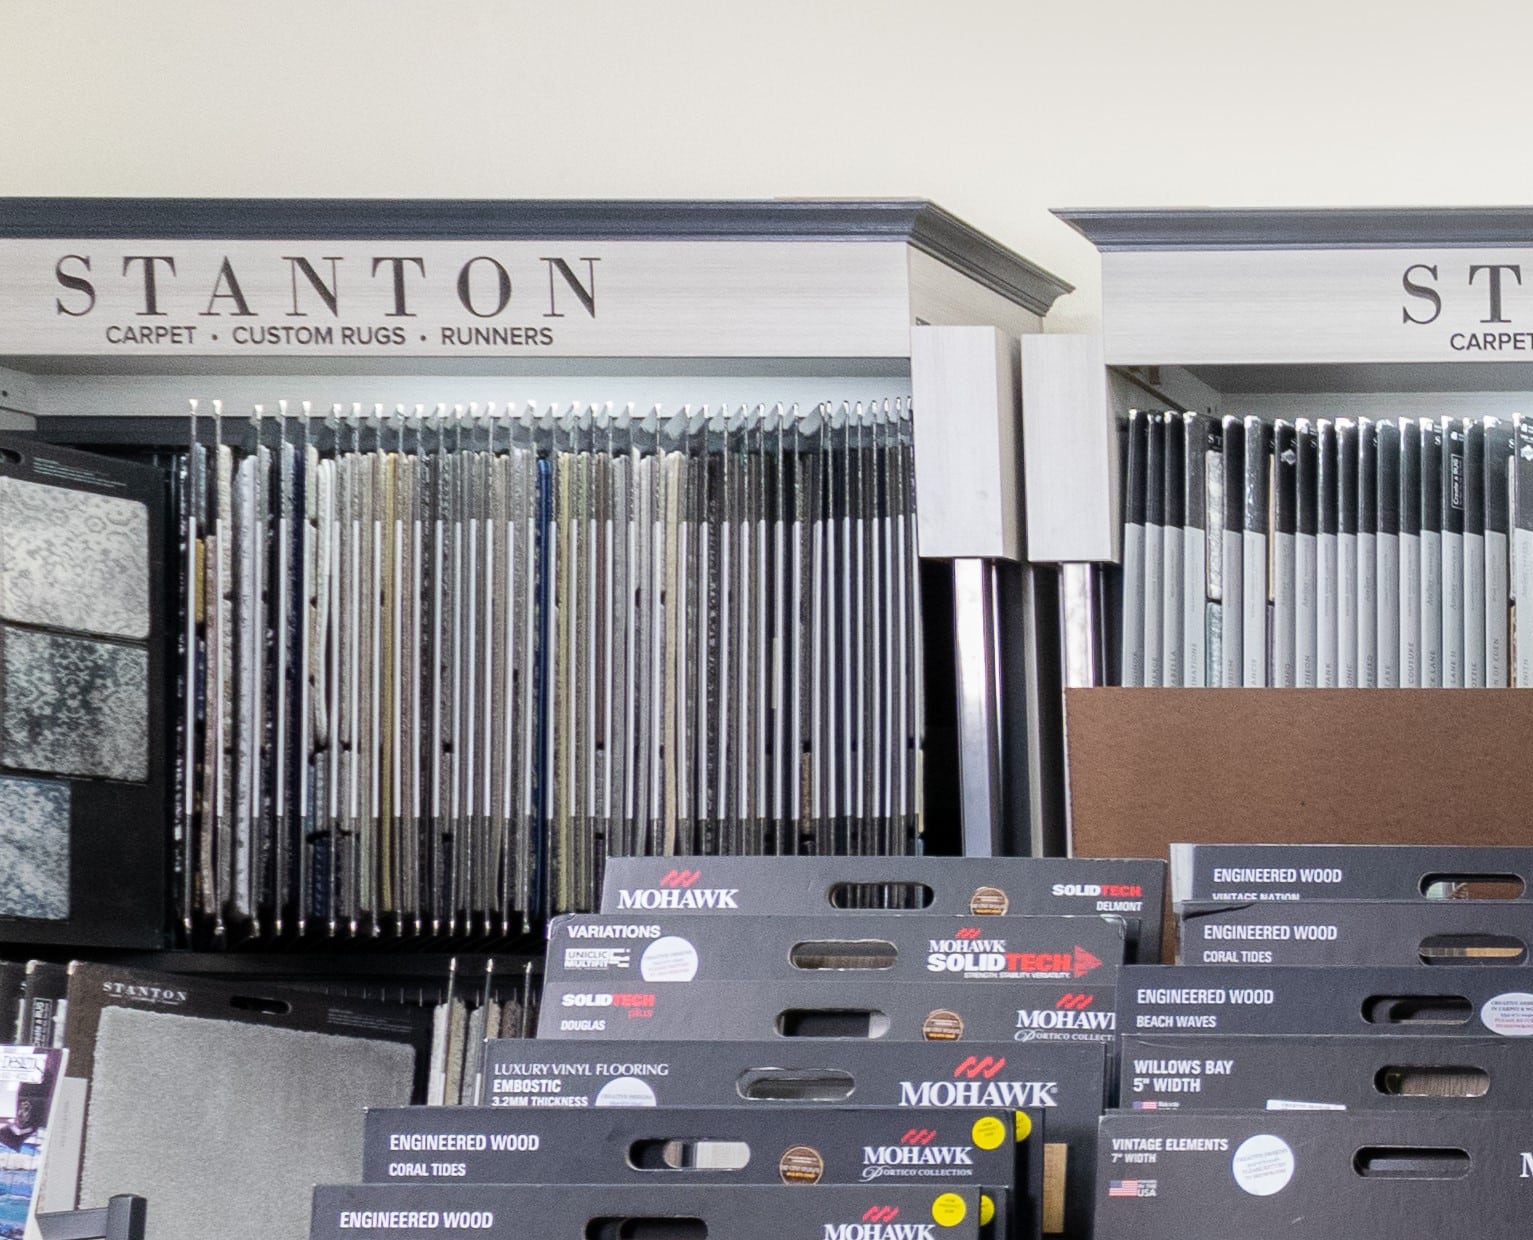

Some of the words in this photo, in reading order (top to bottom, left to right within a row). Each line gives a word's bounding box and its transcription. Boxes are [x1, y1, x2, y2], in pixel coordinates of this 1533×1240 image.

[55, 255, 602, 318] STANTON
[106, 326, 196, 346] CARPET
[232, 326, 334, 346] CUSTOM
[341, 326, 406, 346] RUGS
[441, 326, 554, 346] RUNNERS
[1213, 869, 1297, 883] ENGINEERED
[1300, 869, 1342, 883] WOOD
[1052, 884, 1142, 896] SOLIDTECH
[617, 889, 739, 909] MOHAWK
[1096, 901, 1142, 912] DELMONT
[567, 925, 661, 939] VARIATIONS
[1203, 926, 1290, 940] ENGINEERED
[1293, 926, 1338, 940] WOOD
[928, 939, 1006, 952] MOHAWK
[927, 953, 1072, 972] SOLIDTECH
[1203, 951, 1239, 963] CORAL
[1240, 951, 1273, 963] TIDES
[102, 981, 187, 1001] STANTON
[1137, 989, 1226, 1004] ENGINEERED
[1229, 989, 1274, 1004] WOOD
[561, 993, 655, 1007] SOLIDTECH
[561, 1019, 606, 1031] DOUGLAS
[1016, 1009, 1116, 1029] MOHAW
[1136, 1015, 1173, 1027] BEACH
[1176, 1015, 1217, 1027] WAVES
[494, 1063, 549, 1076] LUXURY
[551, 1063, 593, 1076] VINYL
[595, 1063, 669, 1076] FLOORING
[1133, 1059, 1201, 1075] WILLOWS
[1205, 1059, 1234, 1075] BAY
[492, 1079, 562, 1093] EMBOSTIC
[1153, 1077, 1201, 1092] WIDTH
[491, 1096, 528, 1107] 3.2MM
[530, 1096, 588, 1107] THICKNESS
[898, 1082, 1057, 1107] MOHAWK
[389, 1134, 487, 1151] ENGINEERED
[491, 1134, 540, 1151] WOOD
[1112, 1138, 1163, 1151] VINTAGE
[1165, 1138, 1229, 1151] ELEMENTS
[863, 1146, 973, 1165] MOHAWK
[1124, 1153, 1157, 1163] WIDTH
[389, 1163, 428, 1177] CORAL
[431, 1163, 467, 1177] TIDES
[858, 1165, 916, 1182] PORTICO
[917, 1167, 973, 1177] COLLECTION
[339, 1211, 439, 1229] ENGINEERED
[443, 1211, 493, 1228] WOOD
